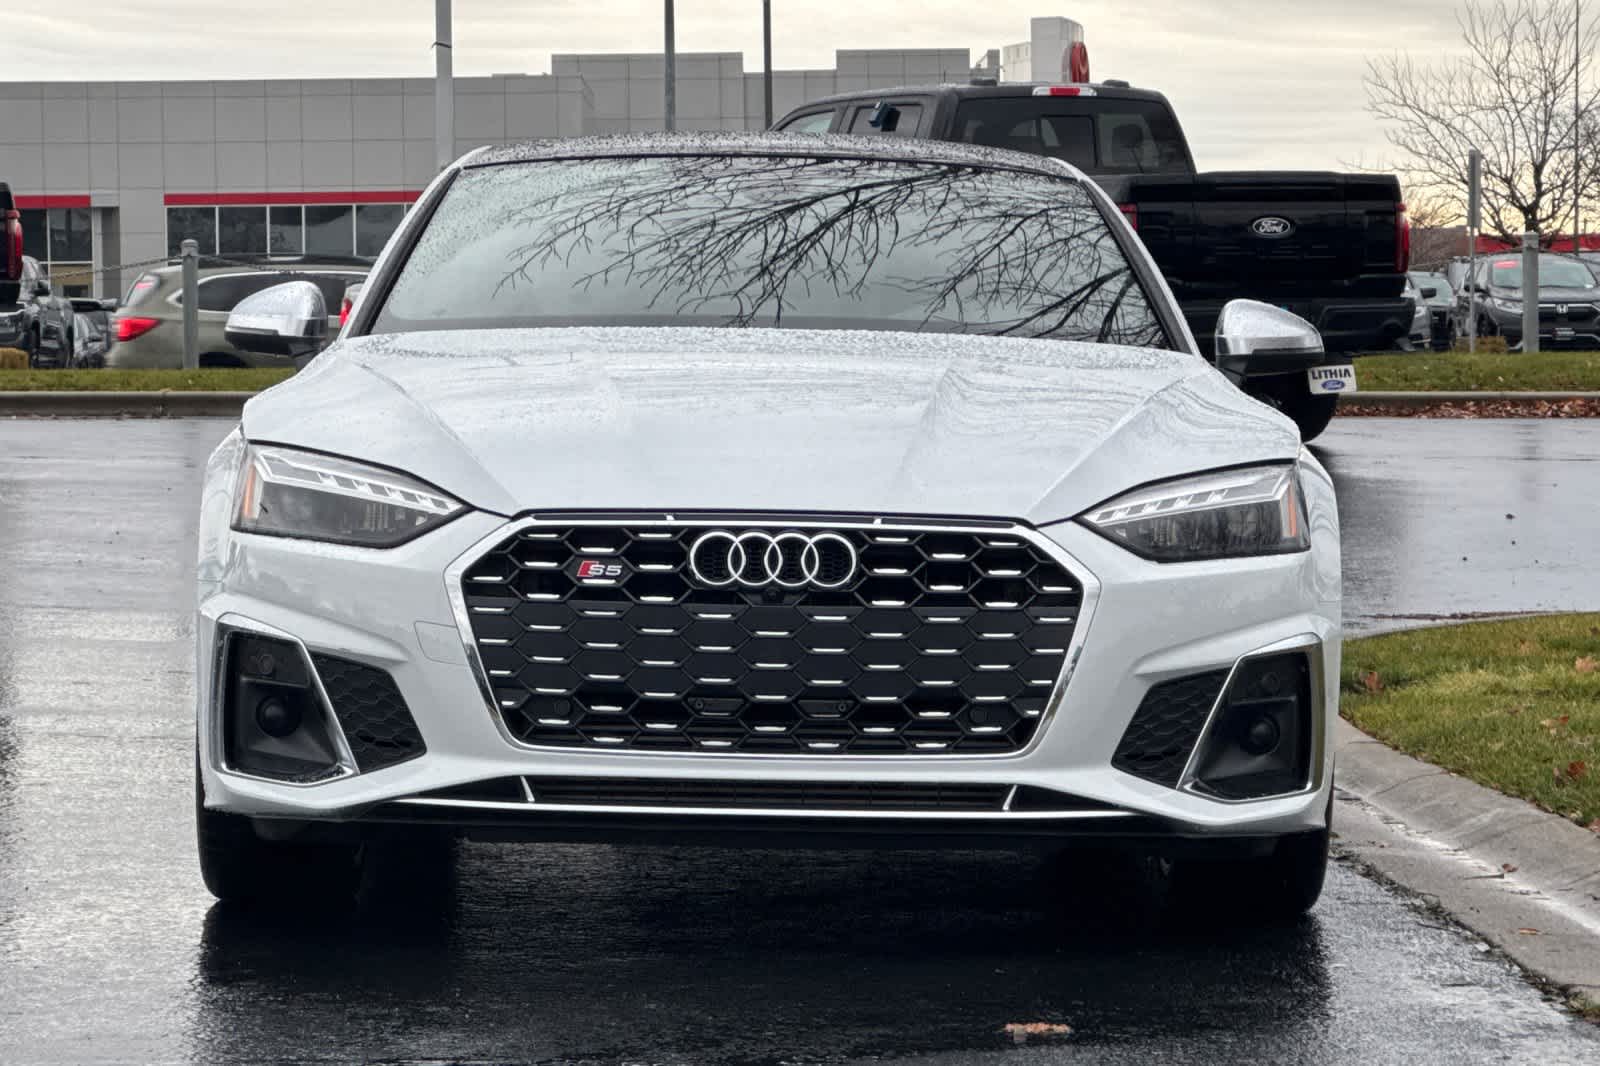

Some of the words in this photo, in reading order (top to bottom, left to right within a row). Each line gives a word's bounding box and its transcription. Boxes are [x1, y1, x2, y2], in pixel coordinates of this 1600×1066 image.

[1259, 220, 1284, 233] Ford
[1311, 368, 1352, 380] LITHIA
[586, 564, 622, 576] S5
